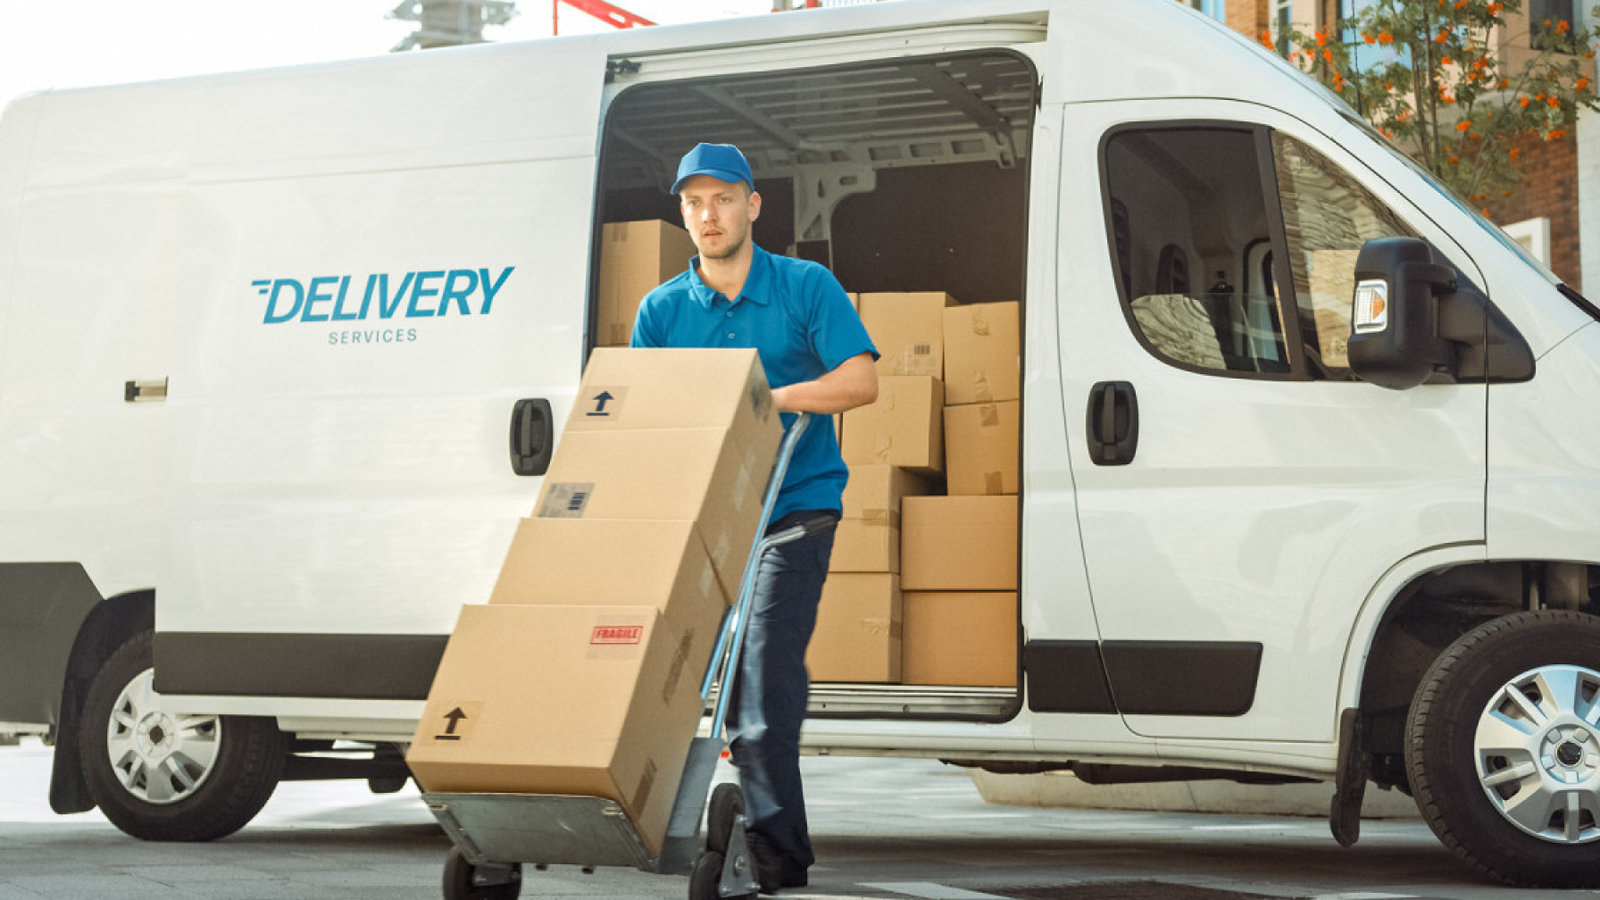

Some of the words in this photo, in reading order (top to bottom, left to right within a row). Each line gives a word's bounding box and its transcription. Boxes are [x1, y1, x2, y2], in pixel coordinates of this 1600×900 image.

[260, 266, 515, 325] DELIVERY
[328, 328, 418, 345] SERVICES
[595, 628, 638, 639] FRAGILE
